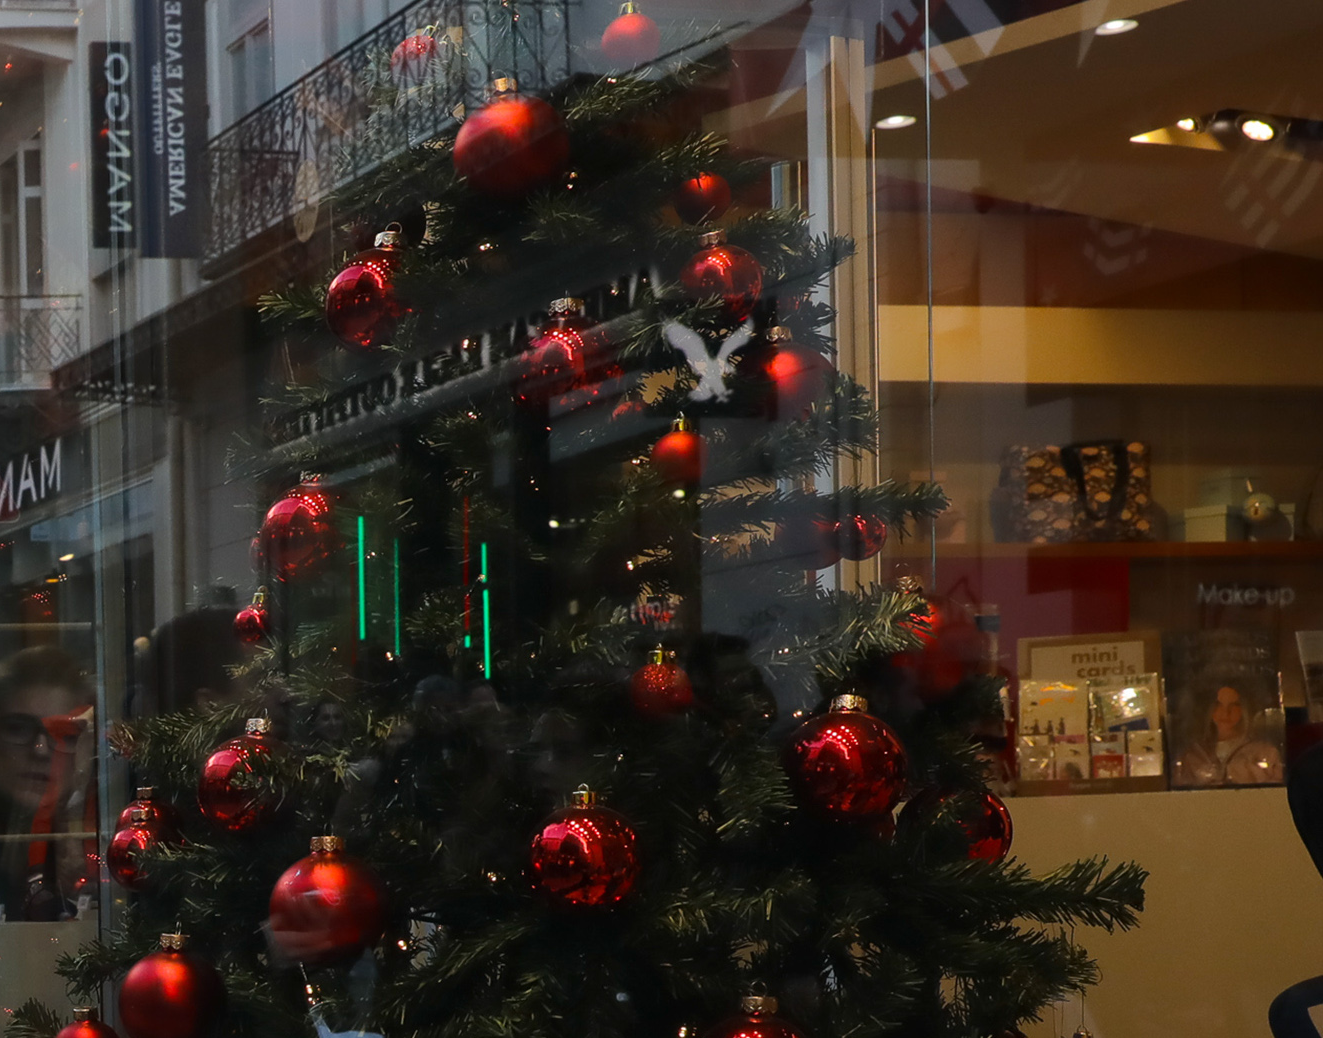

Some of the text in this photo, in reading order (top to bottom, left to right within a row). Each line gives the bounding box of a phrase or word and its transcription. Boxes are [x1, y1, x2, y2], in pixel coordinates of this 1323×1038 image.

[1197, 582, 1296, 610] Make-up
[1071, 646, 1118, 664] mini
[1077, 661, 1136, 680] cards
